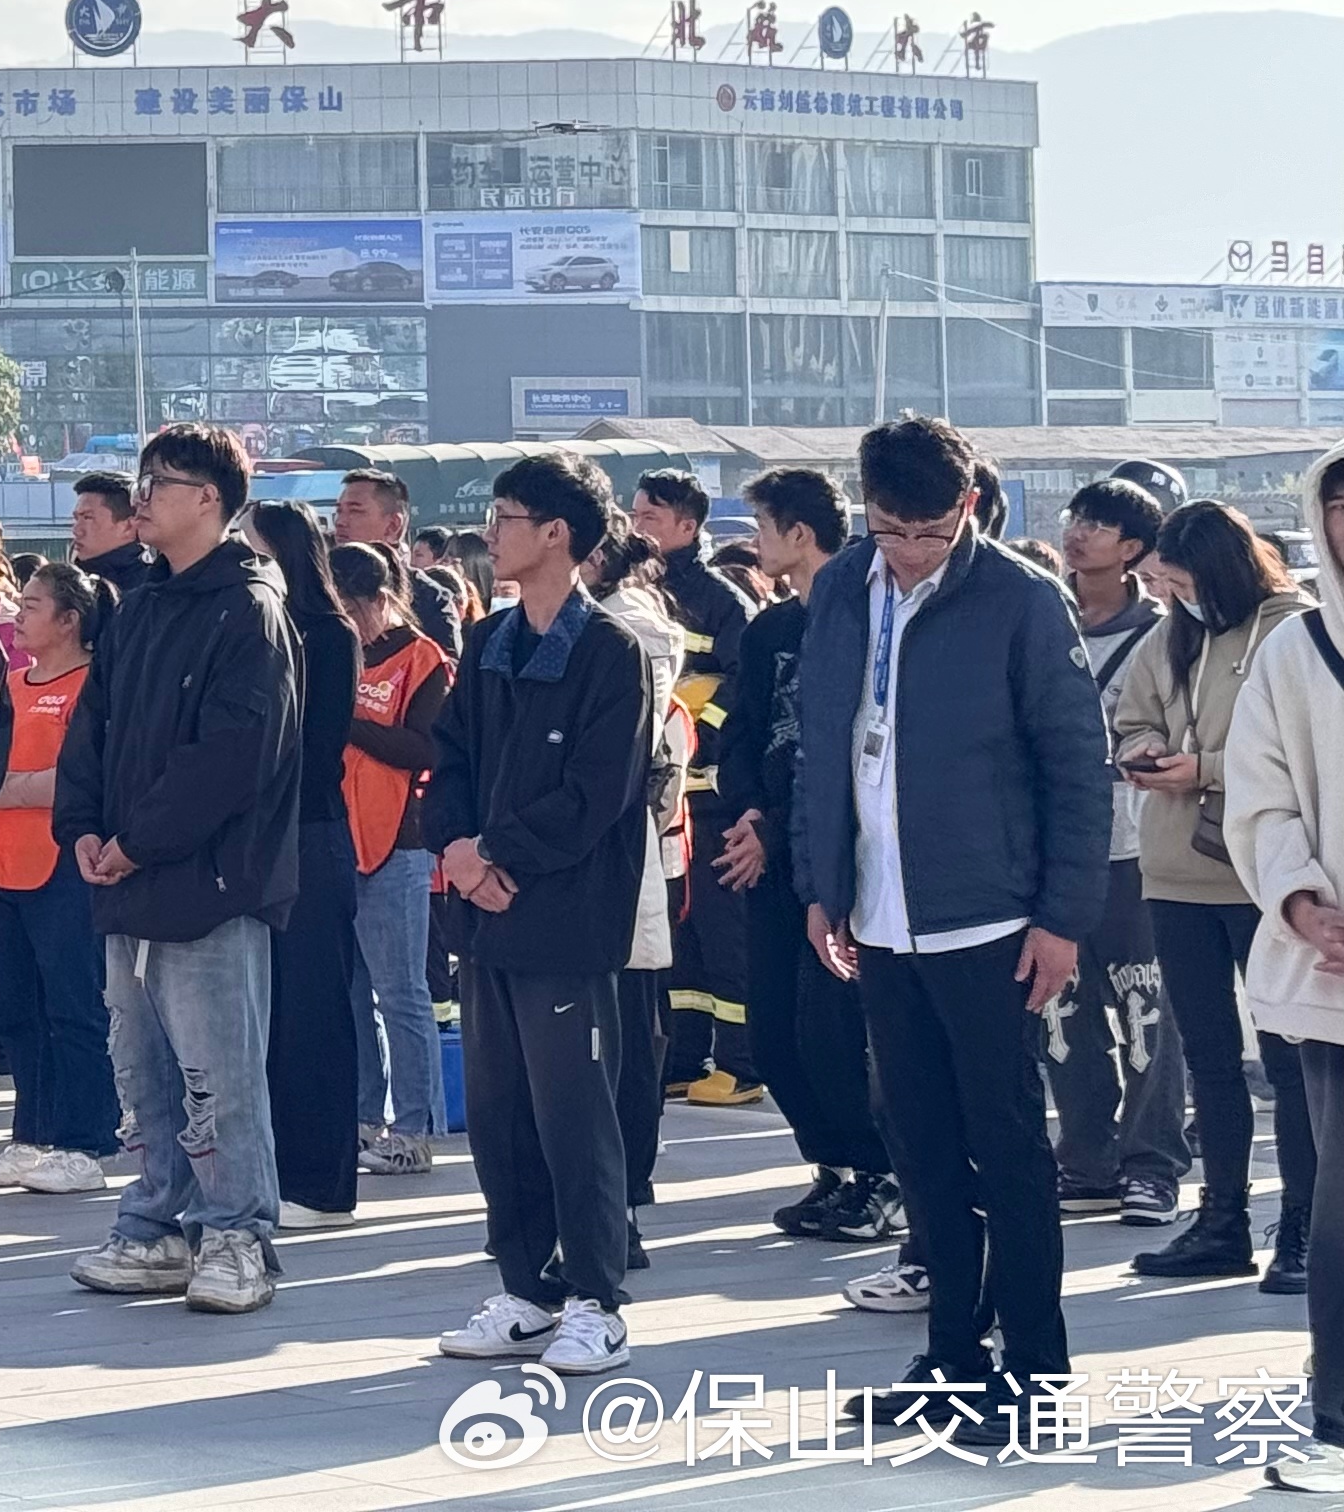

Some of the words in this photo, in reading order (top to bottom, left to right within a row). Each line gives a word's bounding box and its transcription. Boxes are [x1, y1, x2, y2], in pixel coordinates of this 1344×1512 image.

[134, 85, 343, 115] 建设美丽保山
[529, 155, 626, 187] 运营中心
